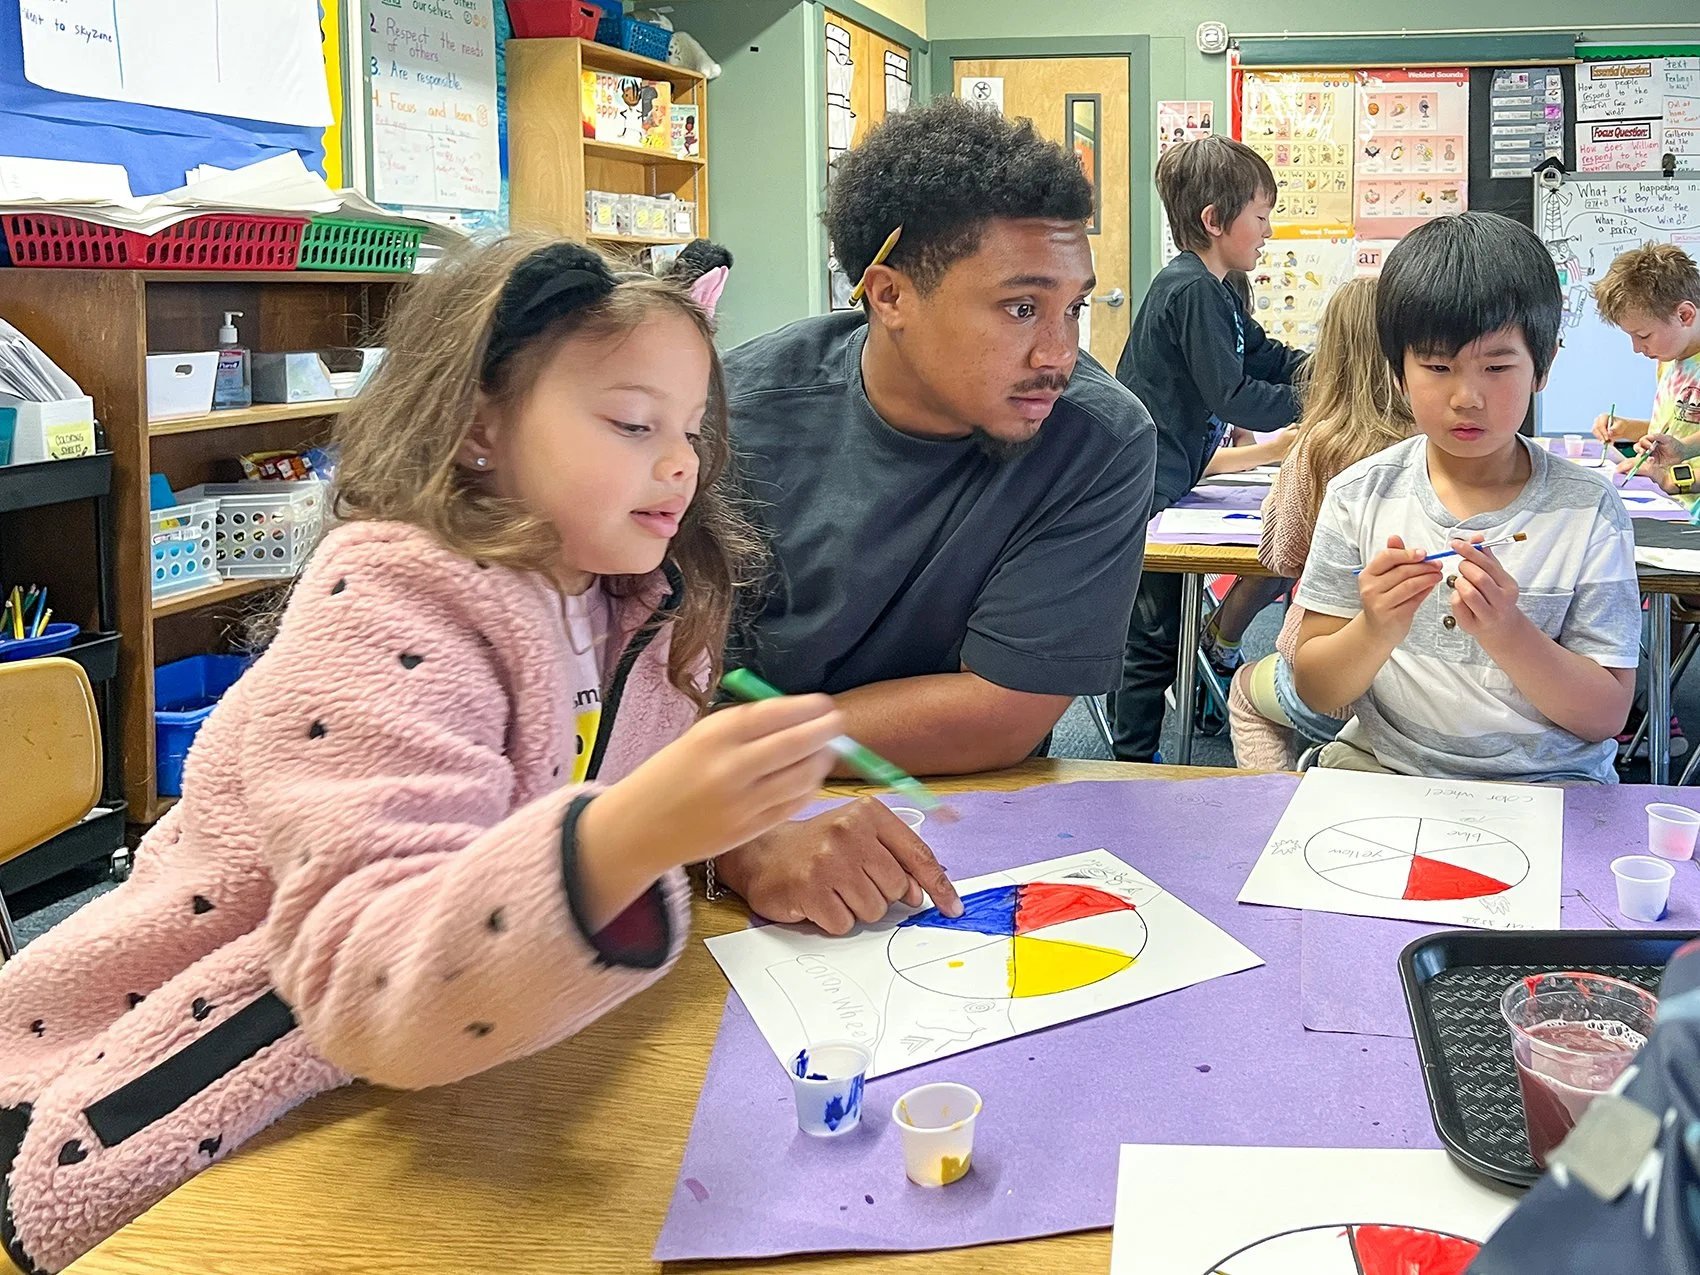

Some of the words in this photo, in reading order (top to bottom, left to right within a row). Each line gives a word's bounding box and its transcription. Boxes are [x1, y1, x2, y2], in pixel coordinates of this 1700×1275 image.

[55, 18, 66, 31] to
[386, 16, 430, 45] Respect
[440, 31, 456, 52] the
[461, 41, 484, 57] needs
[387, 37, 398, 53] of
[390, 60, 408, 80] Are
[1578, 83, 1593, 91] How
[1599, 81, 1607, 89] do
[1615, 80, 1638, 89] people
[1583, 90, 1611, 103] respond
[1634, 97, 1643, 105] of
[390, 92, 417, 113] Focus
[428, 101, 446, 118] and
[454, 103, 474, 122] learn
[1594, 127, 1614, 138] Focus
[1580, 144, 1597, 153] How
[1604, 141, 1623, 152] does
[1631, 140, 1659, 150] William
[1582, 152, 1612, 165] respond
[1634, 150, 1648, 158] the
[1575, 182, 1607, 198] What
[1618, 185, 1627, 194] is
[1611, 195, 1626, 204] The
[1634, 193, 1649, 206] Boy
[1657, 193, 1673, 201] Who
[1672, 202, 1689, 212] the
[1594, 212, 1613, 225] What
[1620, 218, 1628, 226] is
[1656, 213, 1687, 225] Wind?
[1358, 252, 1380, 264] ar
[1424, 787, 1475, 800] wheel
[1446, 830, 1482, 842] blue
[1327, 849, 1383, 859] yellow
[795, 953, 842, 994] Color
